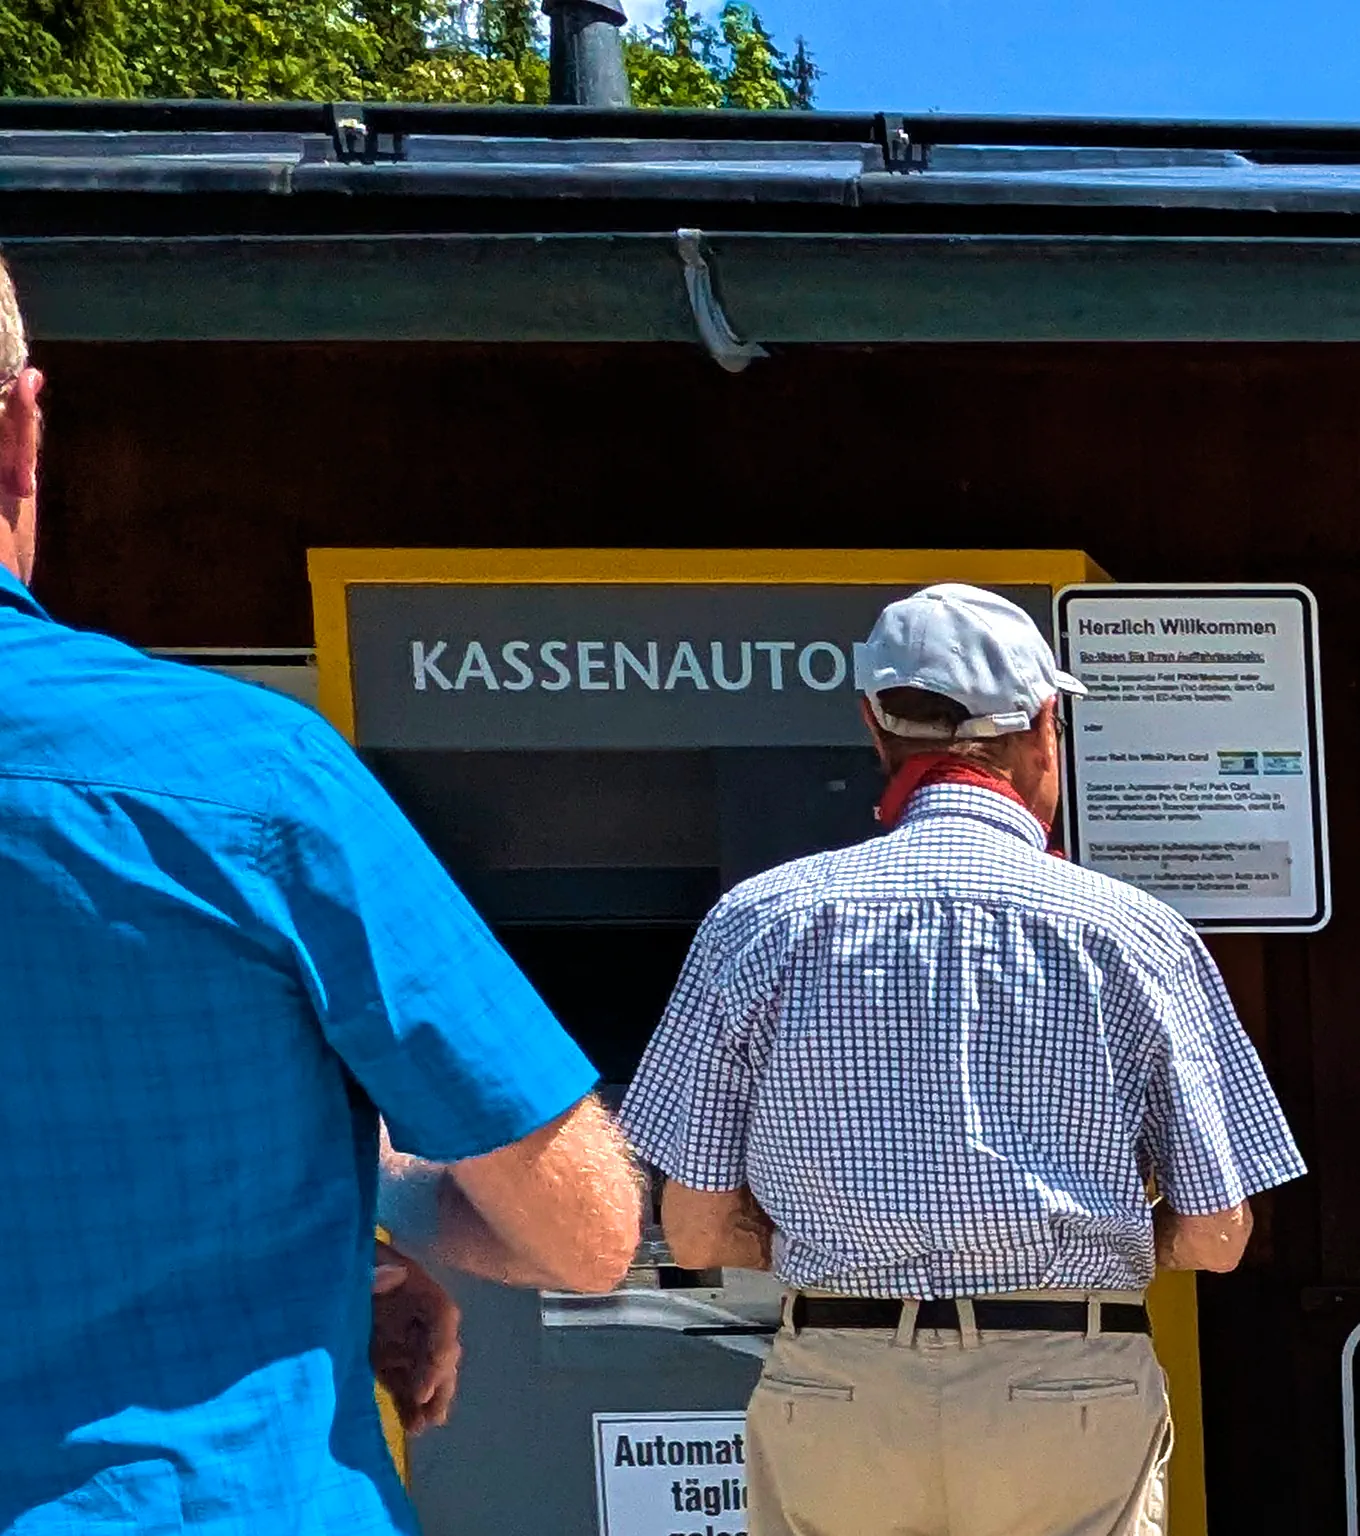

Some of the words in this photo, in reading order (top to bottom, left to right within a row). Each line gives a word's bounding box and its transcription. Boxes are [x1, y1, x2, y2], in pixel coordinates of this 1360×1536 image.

[1078, 618, 1156, 636] Herzlich
[1159, 618, 1277, 636] Willkommen
[410, 639, 866, 692] KASSENAUTO
[614, 1432, 746, 1467] Automat
